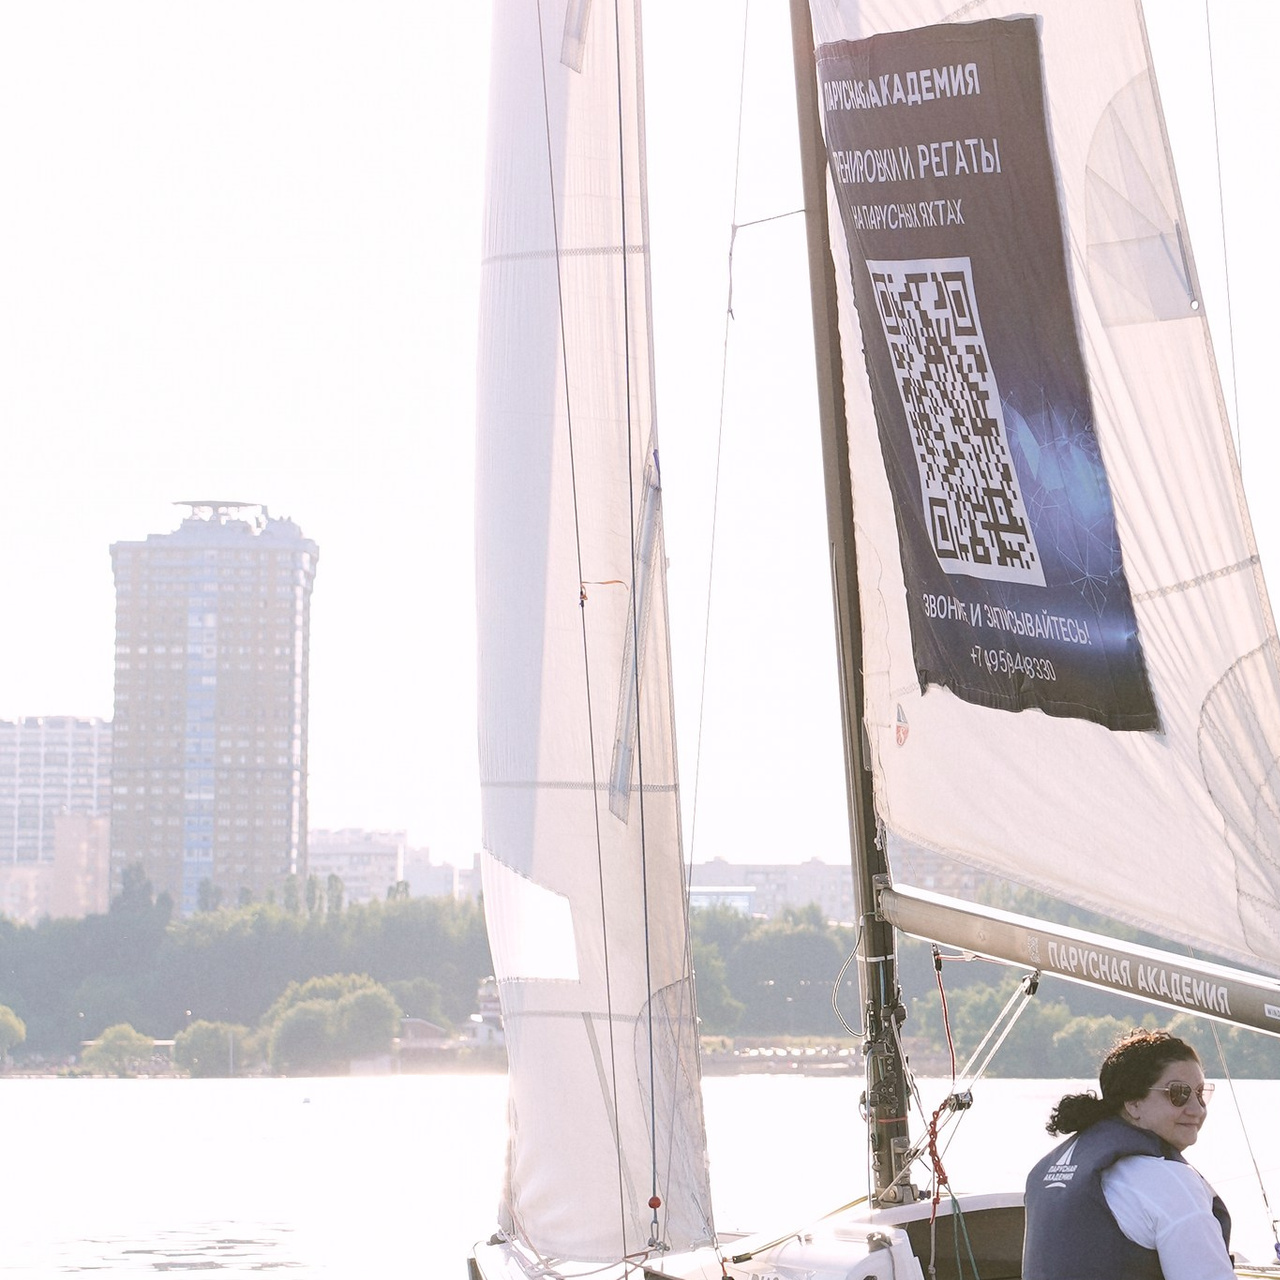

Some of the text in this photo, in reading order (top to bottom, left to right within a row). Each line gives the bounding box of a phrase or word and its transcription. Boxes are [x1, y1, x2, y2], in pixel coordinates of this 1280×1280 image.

[868, 63, 981, 108] АКАДЕМИЯ
[832, 138, 1002, 184] РЕНИРОВКИ И РЕГАТЫ
[919, 199, 965, 227] ЯХТАХ
[970, 603, 982, 628] И
[1048, 941, 1232, 1016] ПАРУСНАЯ АКАДЕМИЯ
